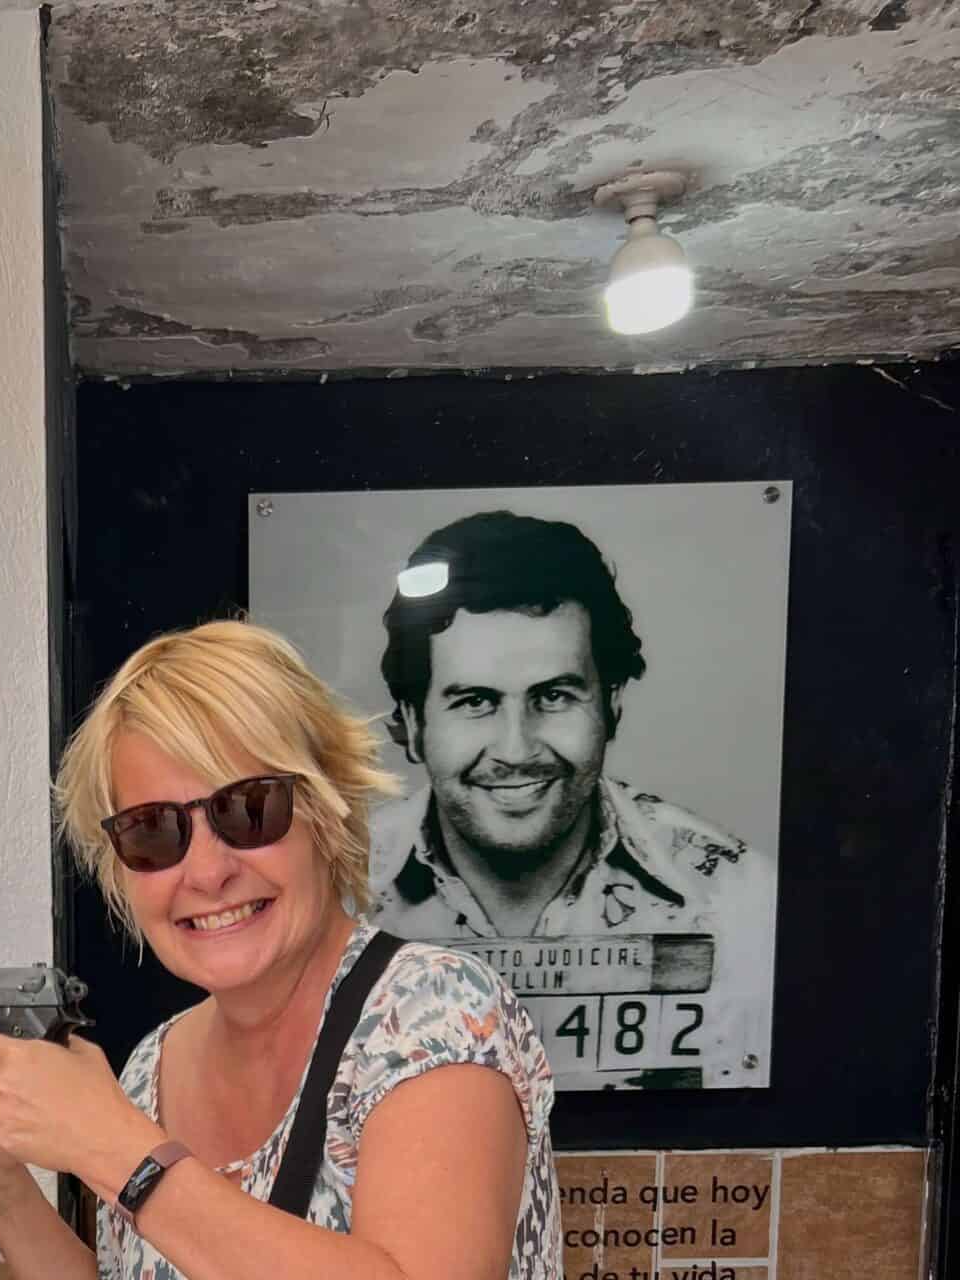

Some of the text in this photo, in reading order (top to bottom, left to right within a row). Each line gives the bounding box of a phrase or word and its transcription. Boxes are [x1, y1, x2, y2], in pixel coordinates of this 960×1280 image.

[472, 950, 522, 967] TTO
[499, 970, 564, 989] LLIN
[639, 1184, 698, 1211] que
[711, 1176, 769, 1210] hoy
[564, 1219, 736, 1248] conocen la
